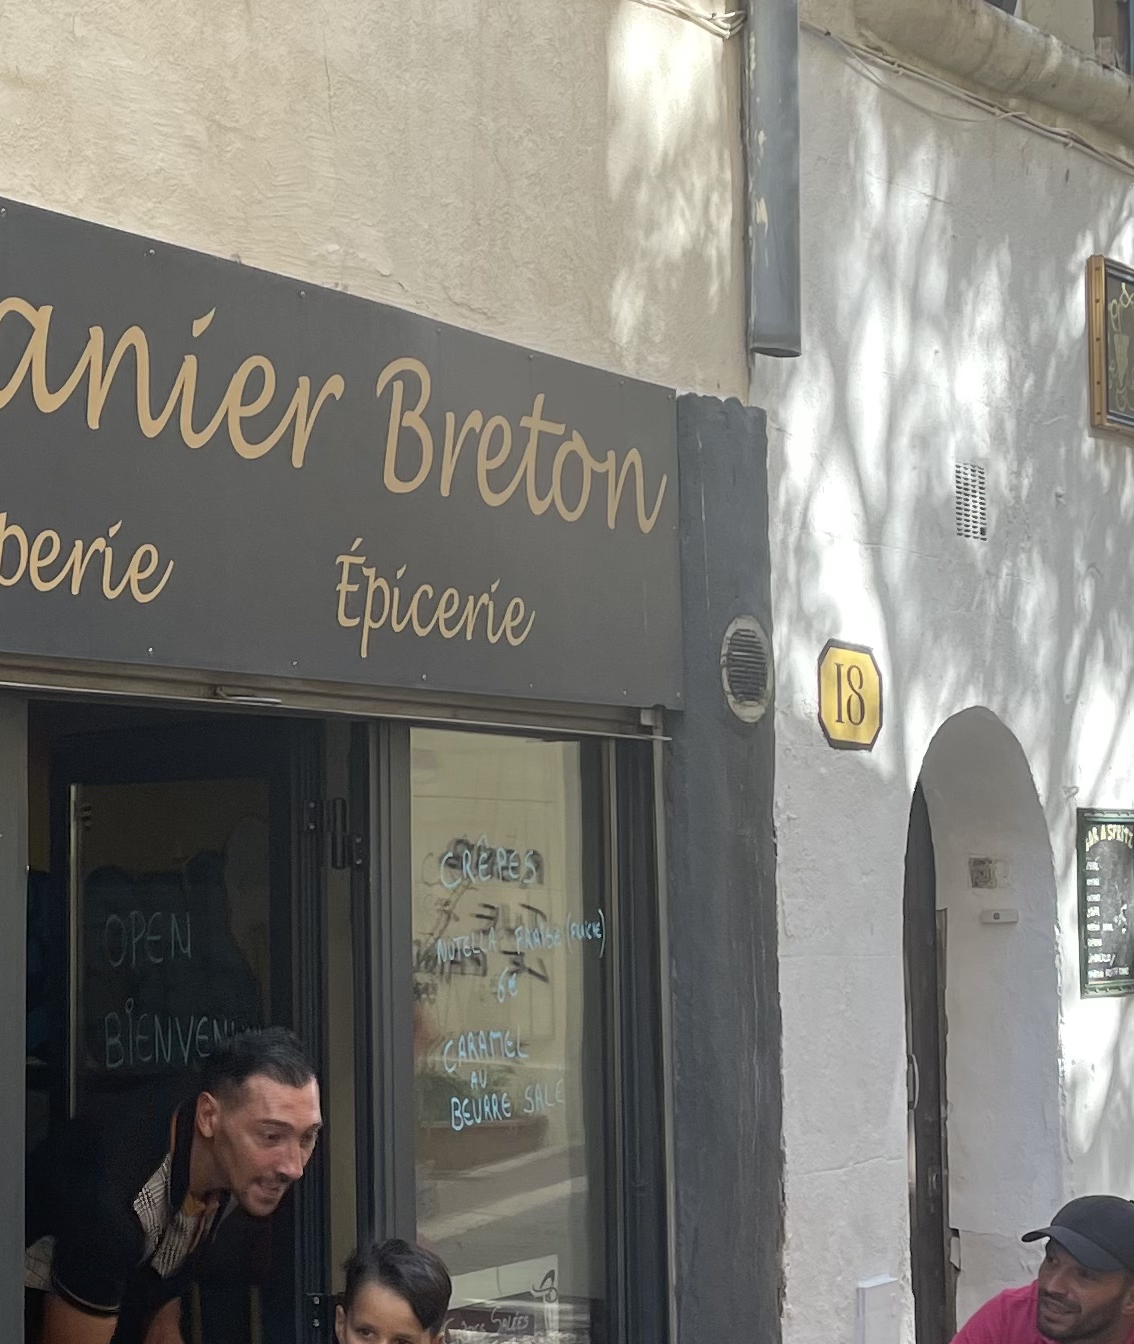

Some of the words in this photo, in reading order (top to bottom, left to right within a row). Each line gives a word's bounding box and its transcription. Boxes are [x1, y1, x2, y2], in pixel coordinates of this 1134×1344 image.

[376, 355, 667, 534] Breton
[335, 536, 535, 657] Épicerie
[834, 662, 865, 726] 18
[104, 910, 192, 967] OPEN
[444, 1029, 529, 1074] CARAMEL
[470, 1070, 488, 1089] AU
[450, 1092, 512, 1132] BEURRE
